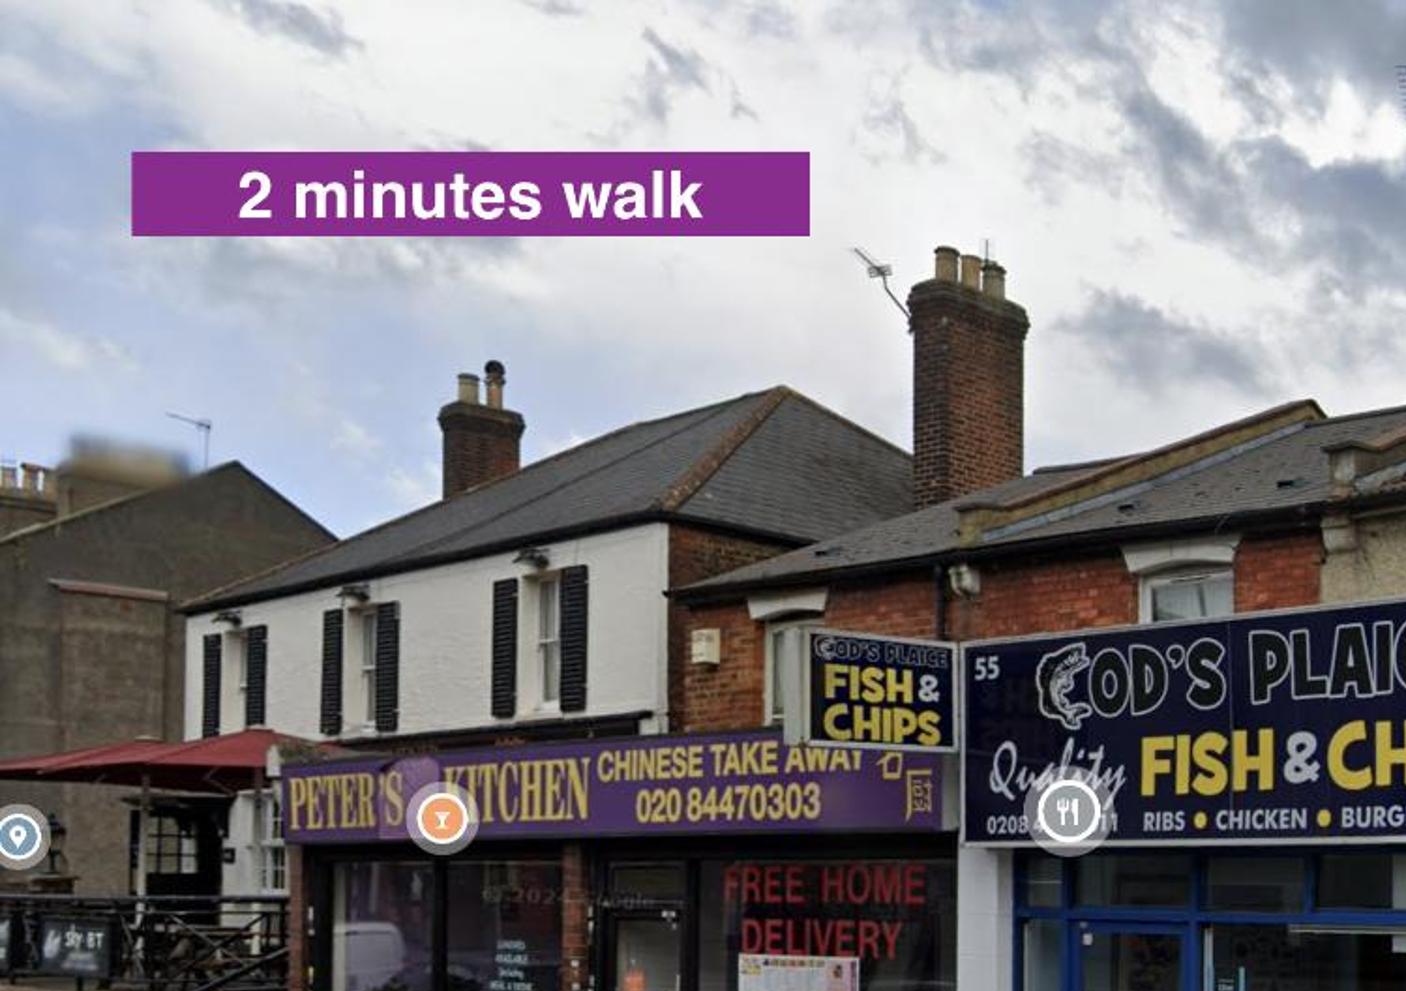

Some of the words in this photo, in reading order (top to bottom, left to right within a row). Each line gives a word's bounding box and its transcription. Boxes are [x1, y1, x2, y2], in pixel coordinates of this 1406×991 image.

[885, 642, 947, 668] PLAICE
[974, 656, 1000, 680] 55
[824, 664, 914, 704] FISH
[918, 674, 940, 702] &
[824, 703, 942, 746] CHIPS
[597, 744, 704, 783] CHINESE
[710, 741, 779, 777] TAKE
[785, 748, 862, 774] AWAY
[1140, 728, 1275, 797] FISH
[1283, 731, 1321, 784] &
[290, 770, 404, 830] PETER'S
[444, 757, 591, 823] KITCHEN
[636, 788, 681, 823] 020
[686, 782, 821, 822] 84470303
[1143, 811, 1186, 832] RIBS
[1216, 808, 1308, 831] CHICKEN
[723, 866, 805, 903] FREE
[822, 865, 927, 903] HOME
[741, 918, 904, 960] DELIVERY
